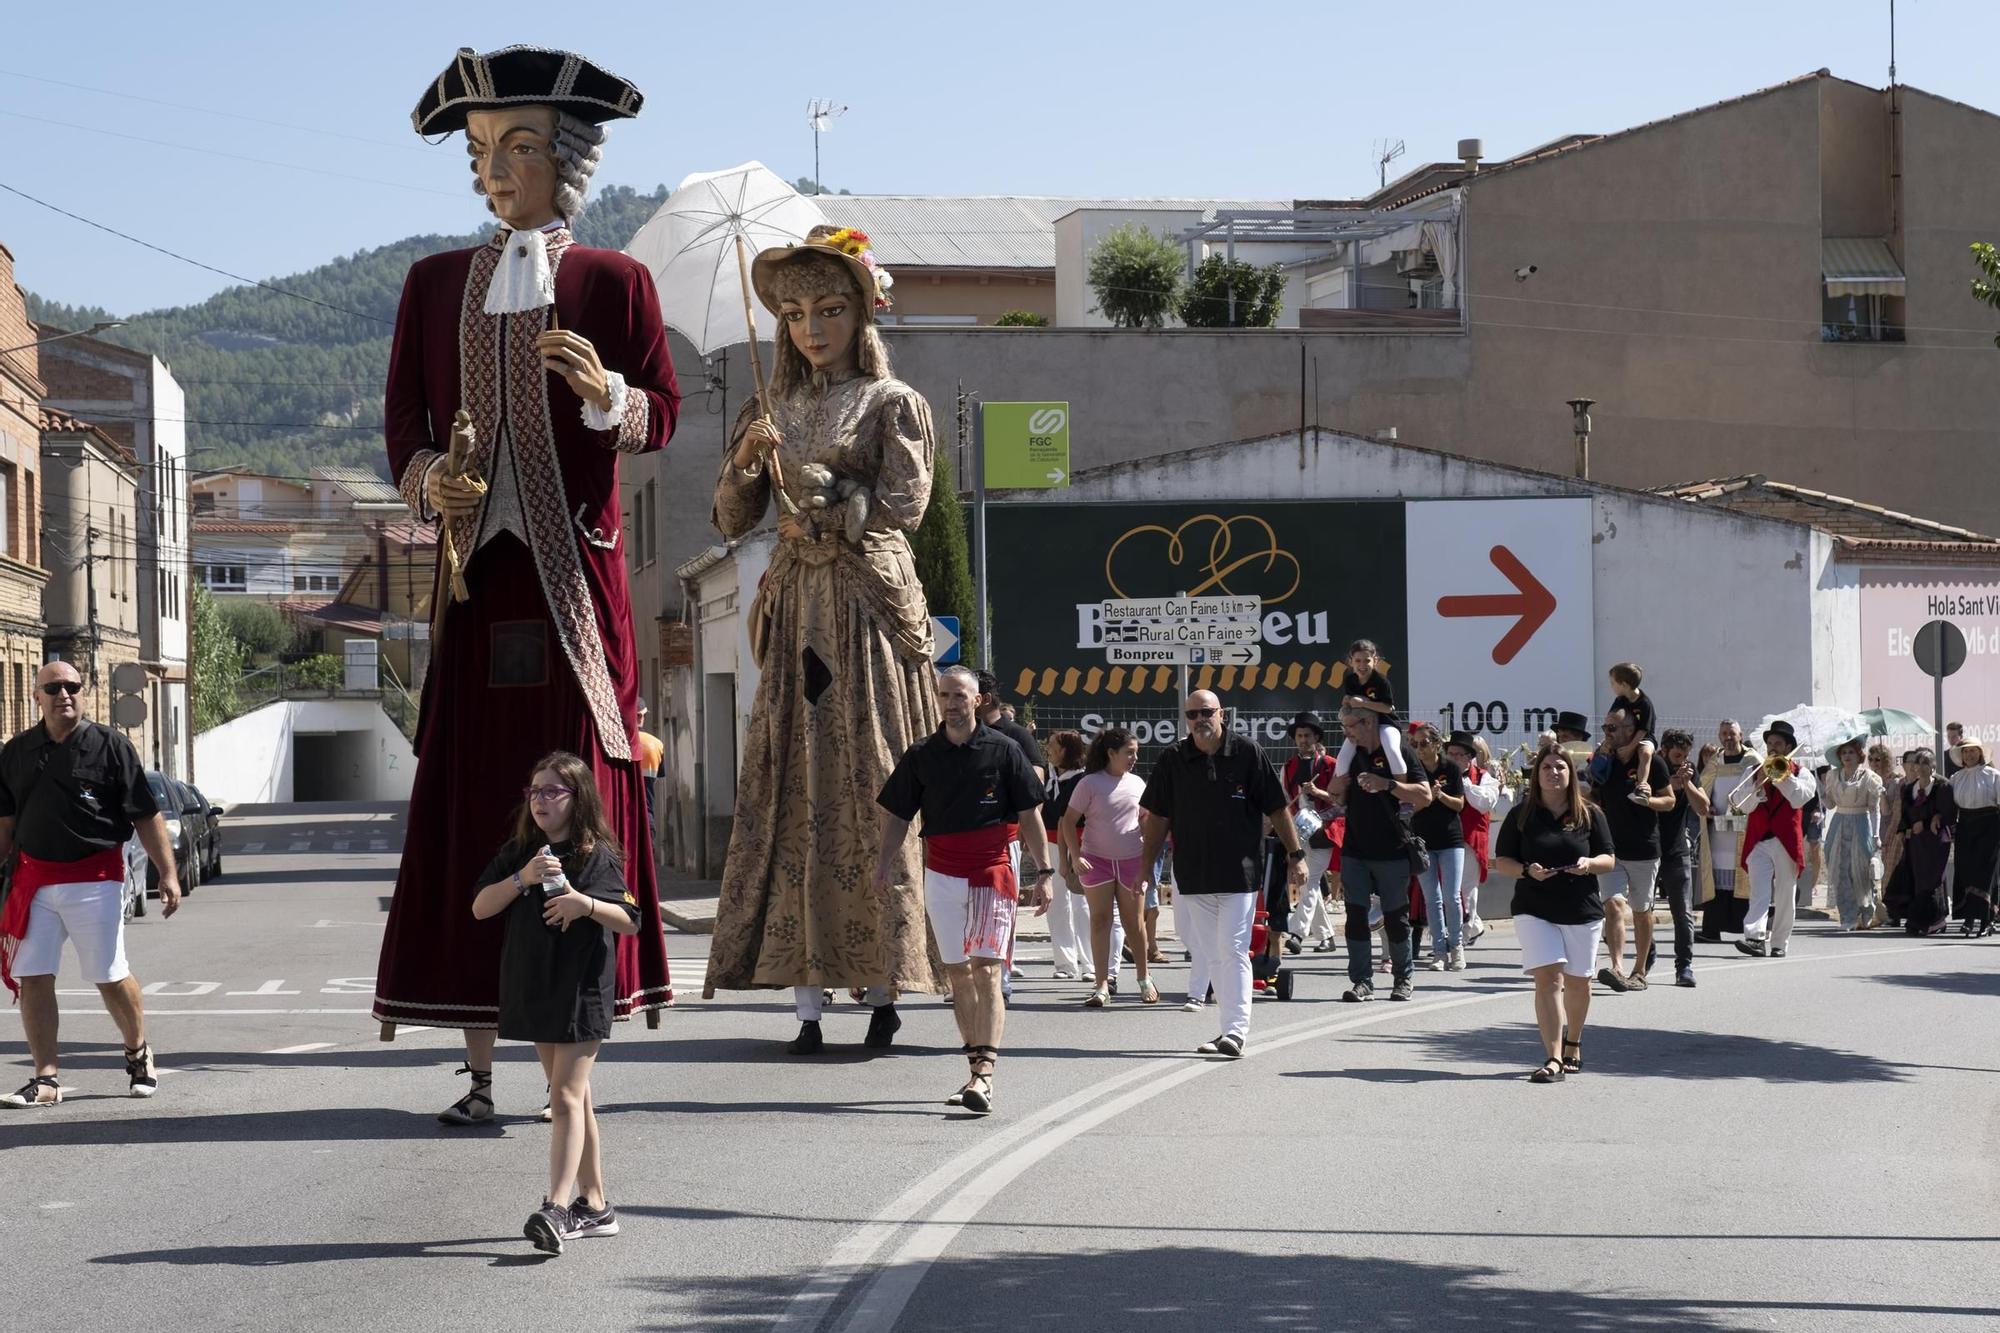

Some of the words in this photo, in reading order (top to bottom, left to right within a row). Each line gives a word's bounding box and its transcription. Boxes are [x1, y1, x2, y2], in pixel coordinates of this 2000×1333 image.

[1029, 437, 1052, 446] FGC
[1104, 603, 1161, 618] Restaurant
[1165, 601, 1188, 616] Can
[1190, 600, 1218, 615] Faine
[1232, 600, 1244, 613] km
[1927, 595, 1956, 616] Hola
[1958, 595, 1984, 616] Sant
[1986, 595, 2000, 616] Vi
[1139, 627, 1174, 641] Rural
[1178, 626, 1205, 640] Can
[1208, 625, 1243, 640] Faine
[1887, 627, 1911, 657] Els
[1113, 648, 1174, 662] Bonpreu
[1439, 700, 1509, 734] 100
[1524, 707, 1558, 733] m
